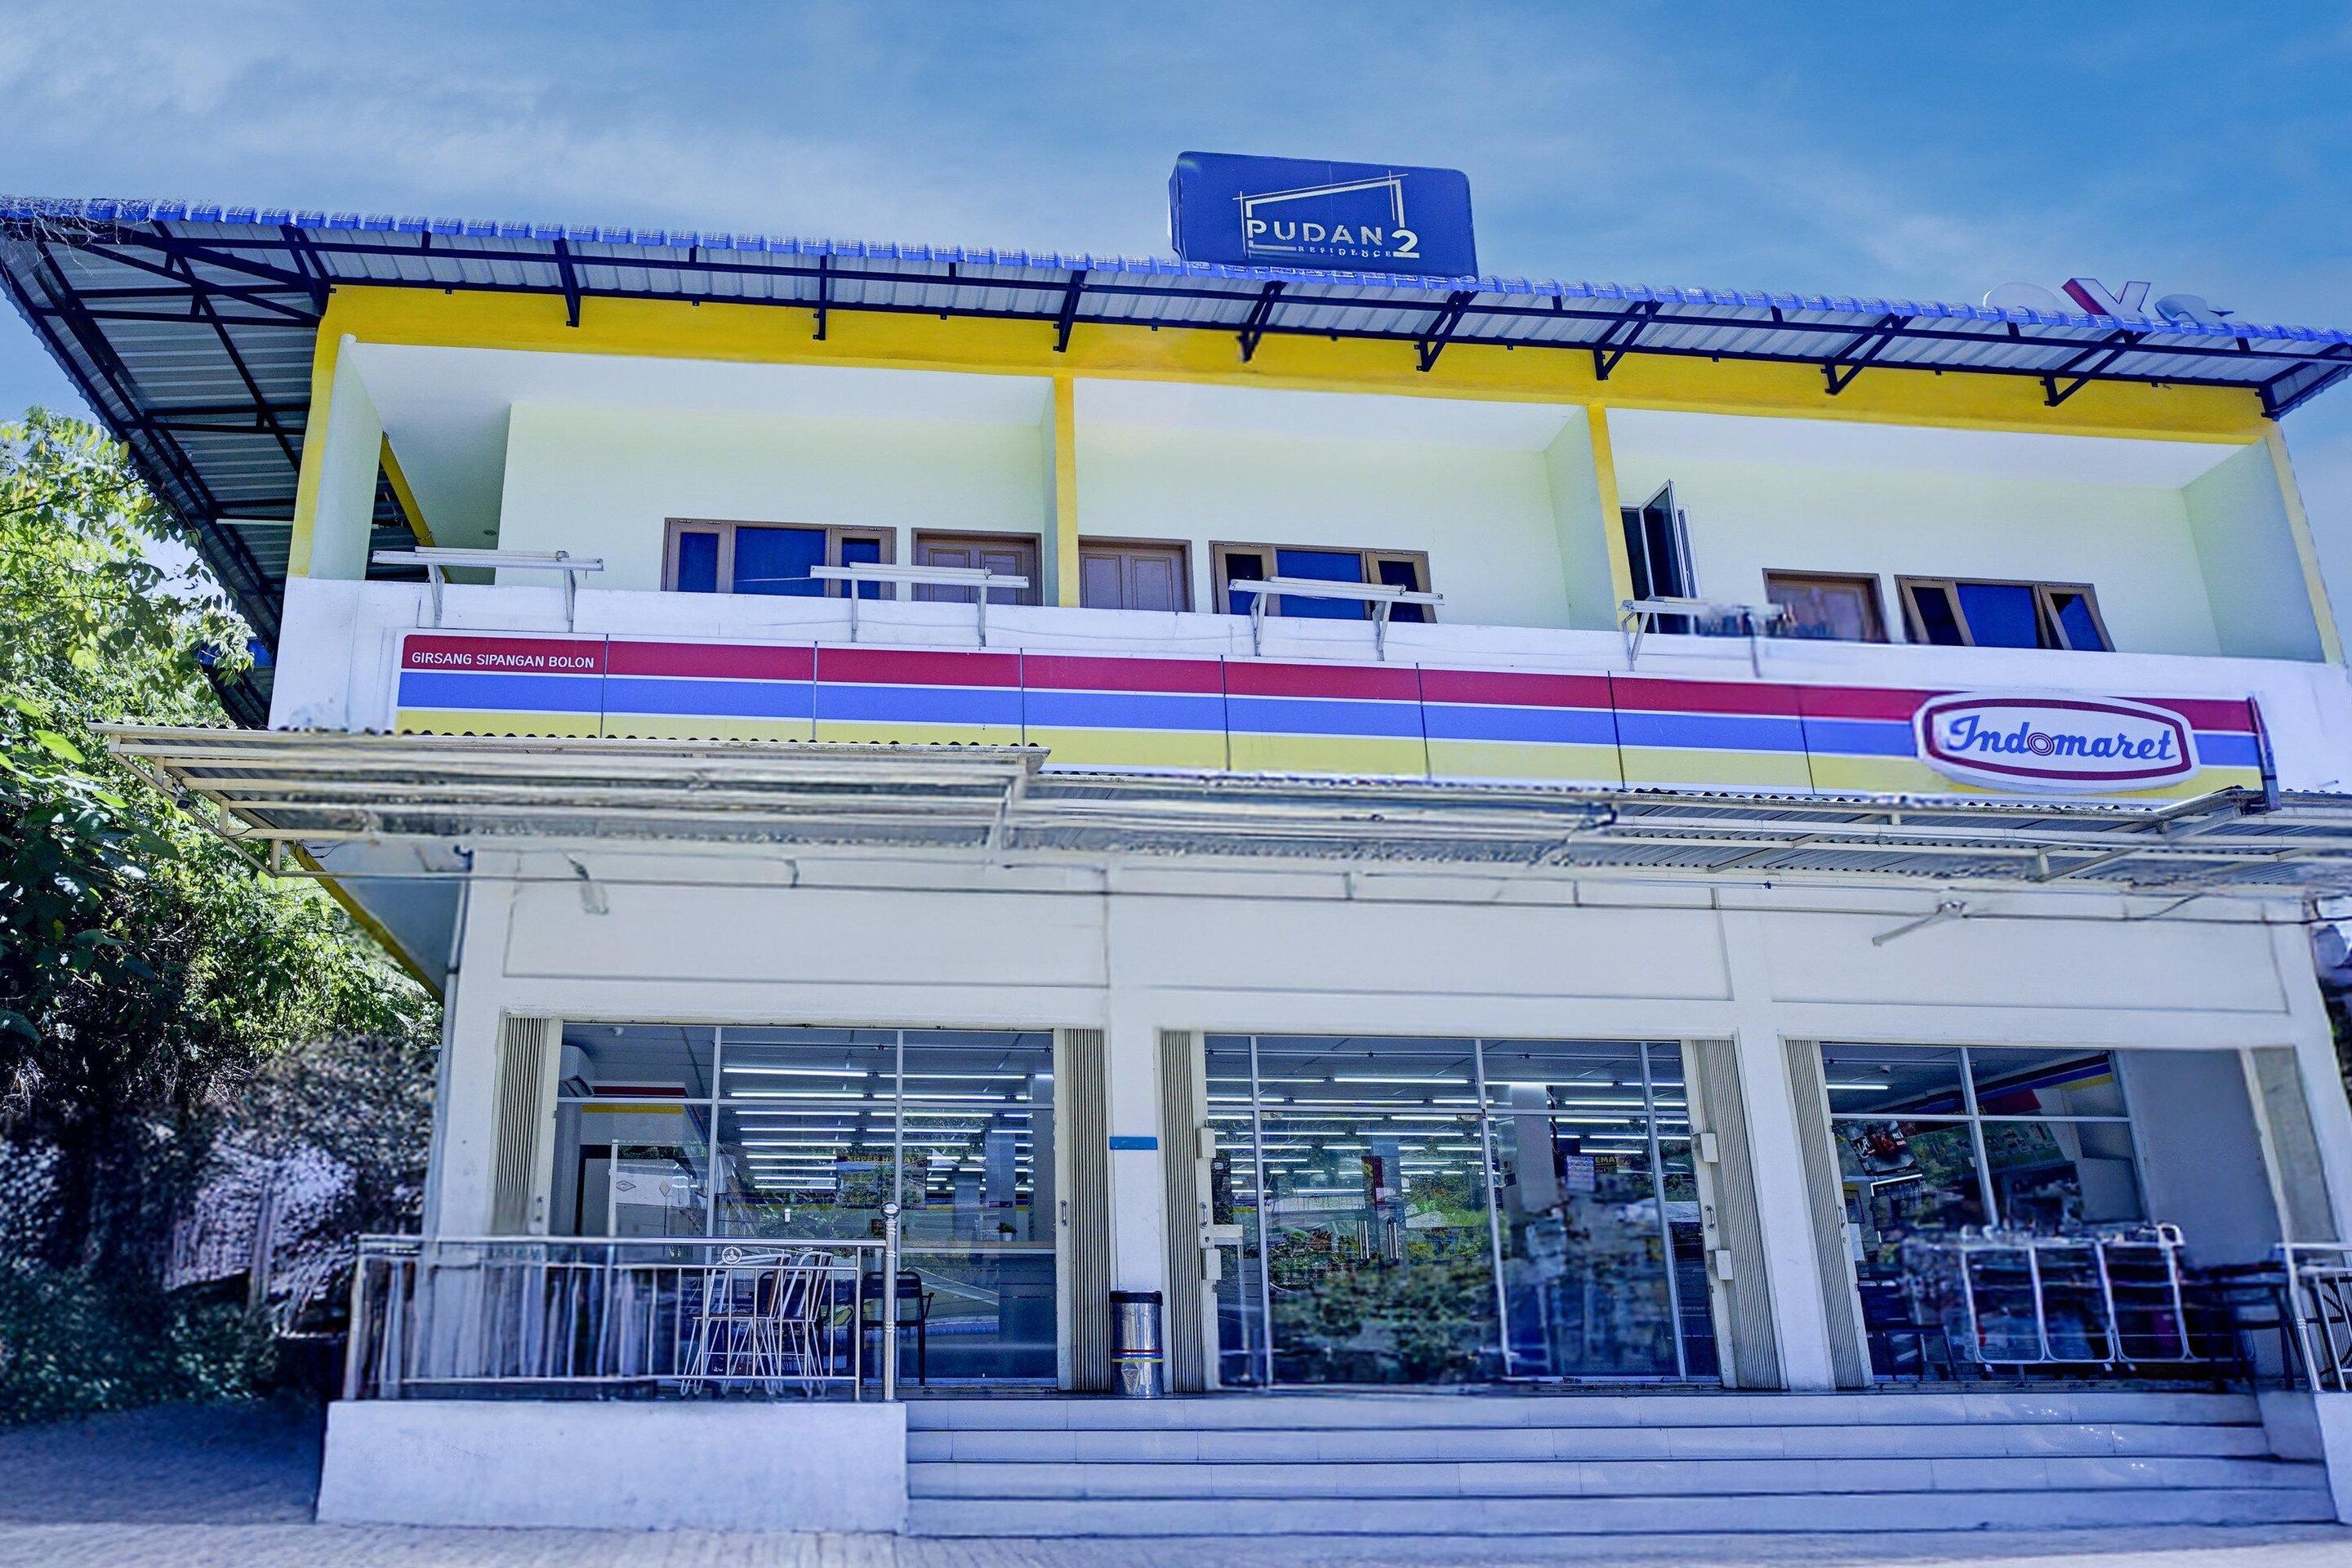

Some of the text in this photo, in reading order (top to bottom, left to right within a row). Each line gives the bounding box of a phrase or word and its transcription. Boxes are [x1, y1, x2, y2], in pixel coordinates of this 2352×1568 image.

[1246, 219, 1420, 259] PUDAN 2
[412, 652, 595, 669] GIRSANG SIPANGAN BOLON
[1948, 715, 2176, 760] Indomaret
